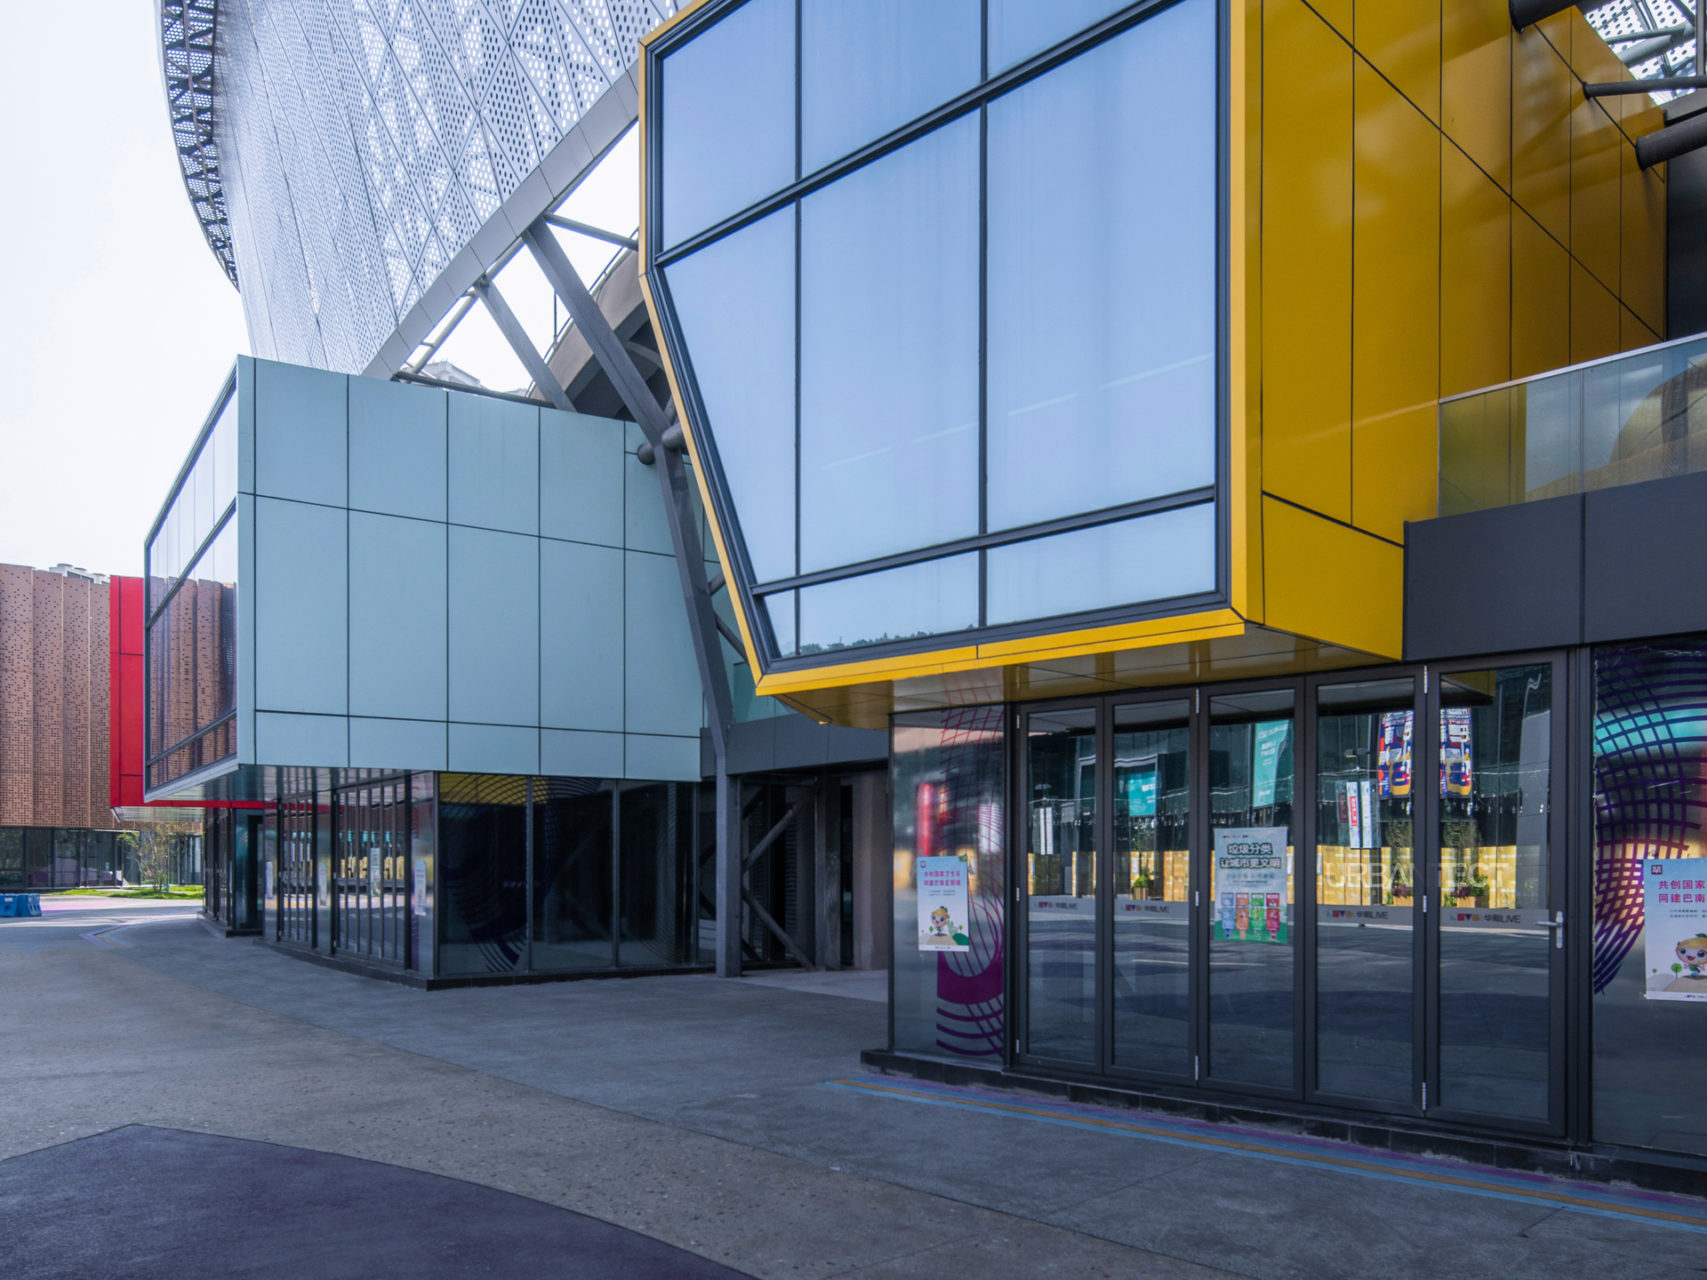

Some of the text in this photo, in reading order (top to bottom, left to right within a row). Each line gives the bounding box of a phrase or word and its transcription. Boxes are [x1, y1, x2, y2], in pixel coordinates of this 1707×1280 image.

[1227, 842, 1273, 855] 垃圾分类
[1220, 857, 1281, 869] 让城市更文明
[1658, 880, 1705, 889] 共创国家
[1658, 893, 1705, 903] 同建巴南
